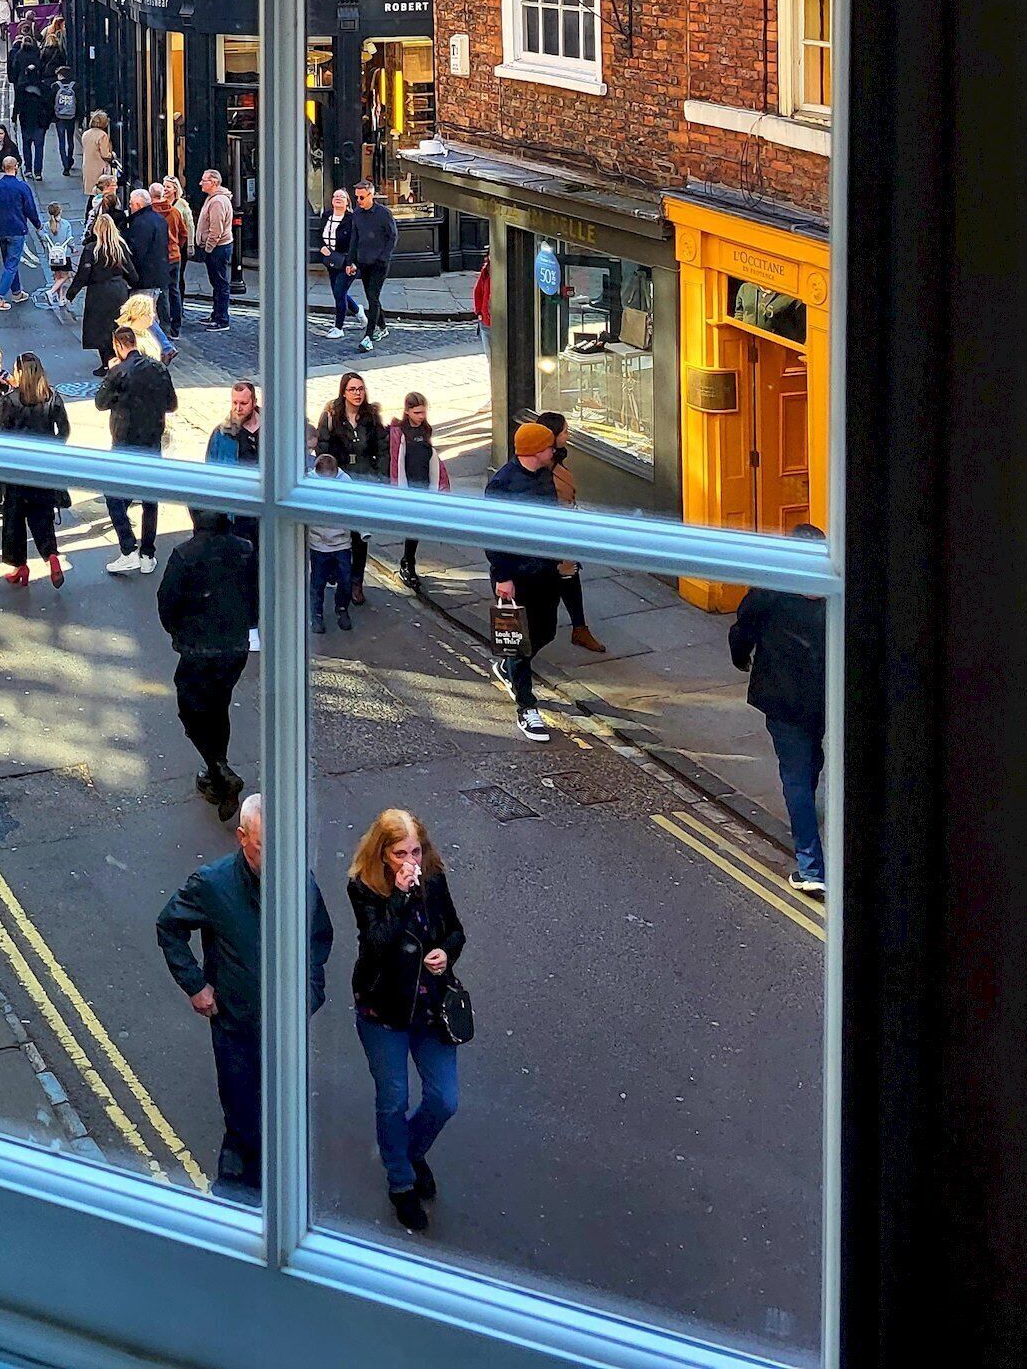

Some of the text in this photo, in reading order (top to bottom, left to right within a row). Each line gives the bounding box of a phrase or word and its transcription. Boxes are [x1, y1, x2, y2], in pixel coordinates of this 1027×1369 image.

[384, 2, 429, 12] ROBERT
[733, 250, 785, 276] L'OCCITANE
[495, 630, 523, 640] Look Big
